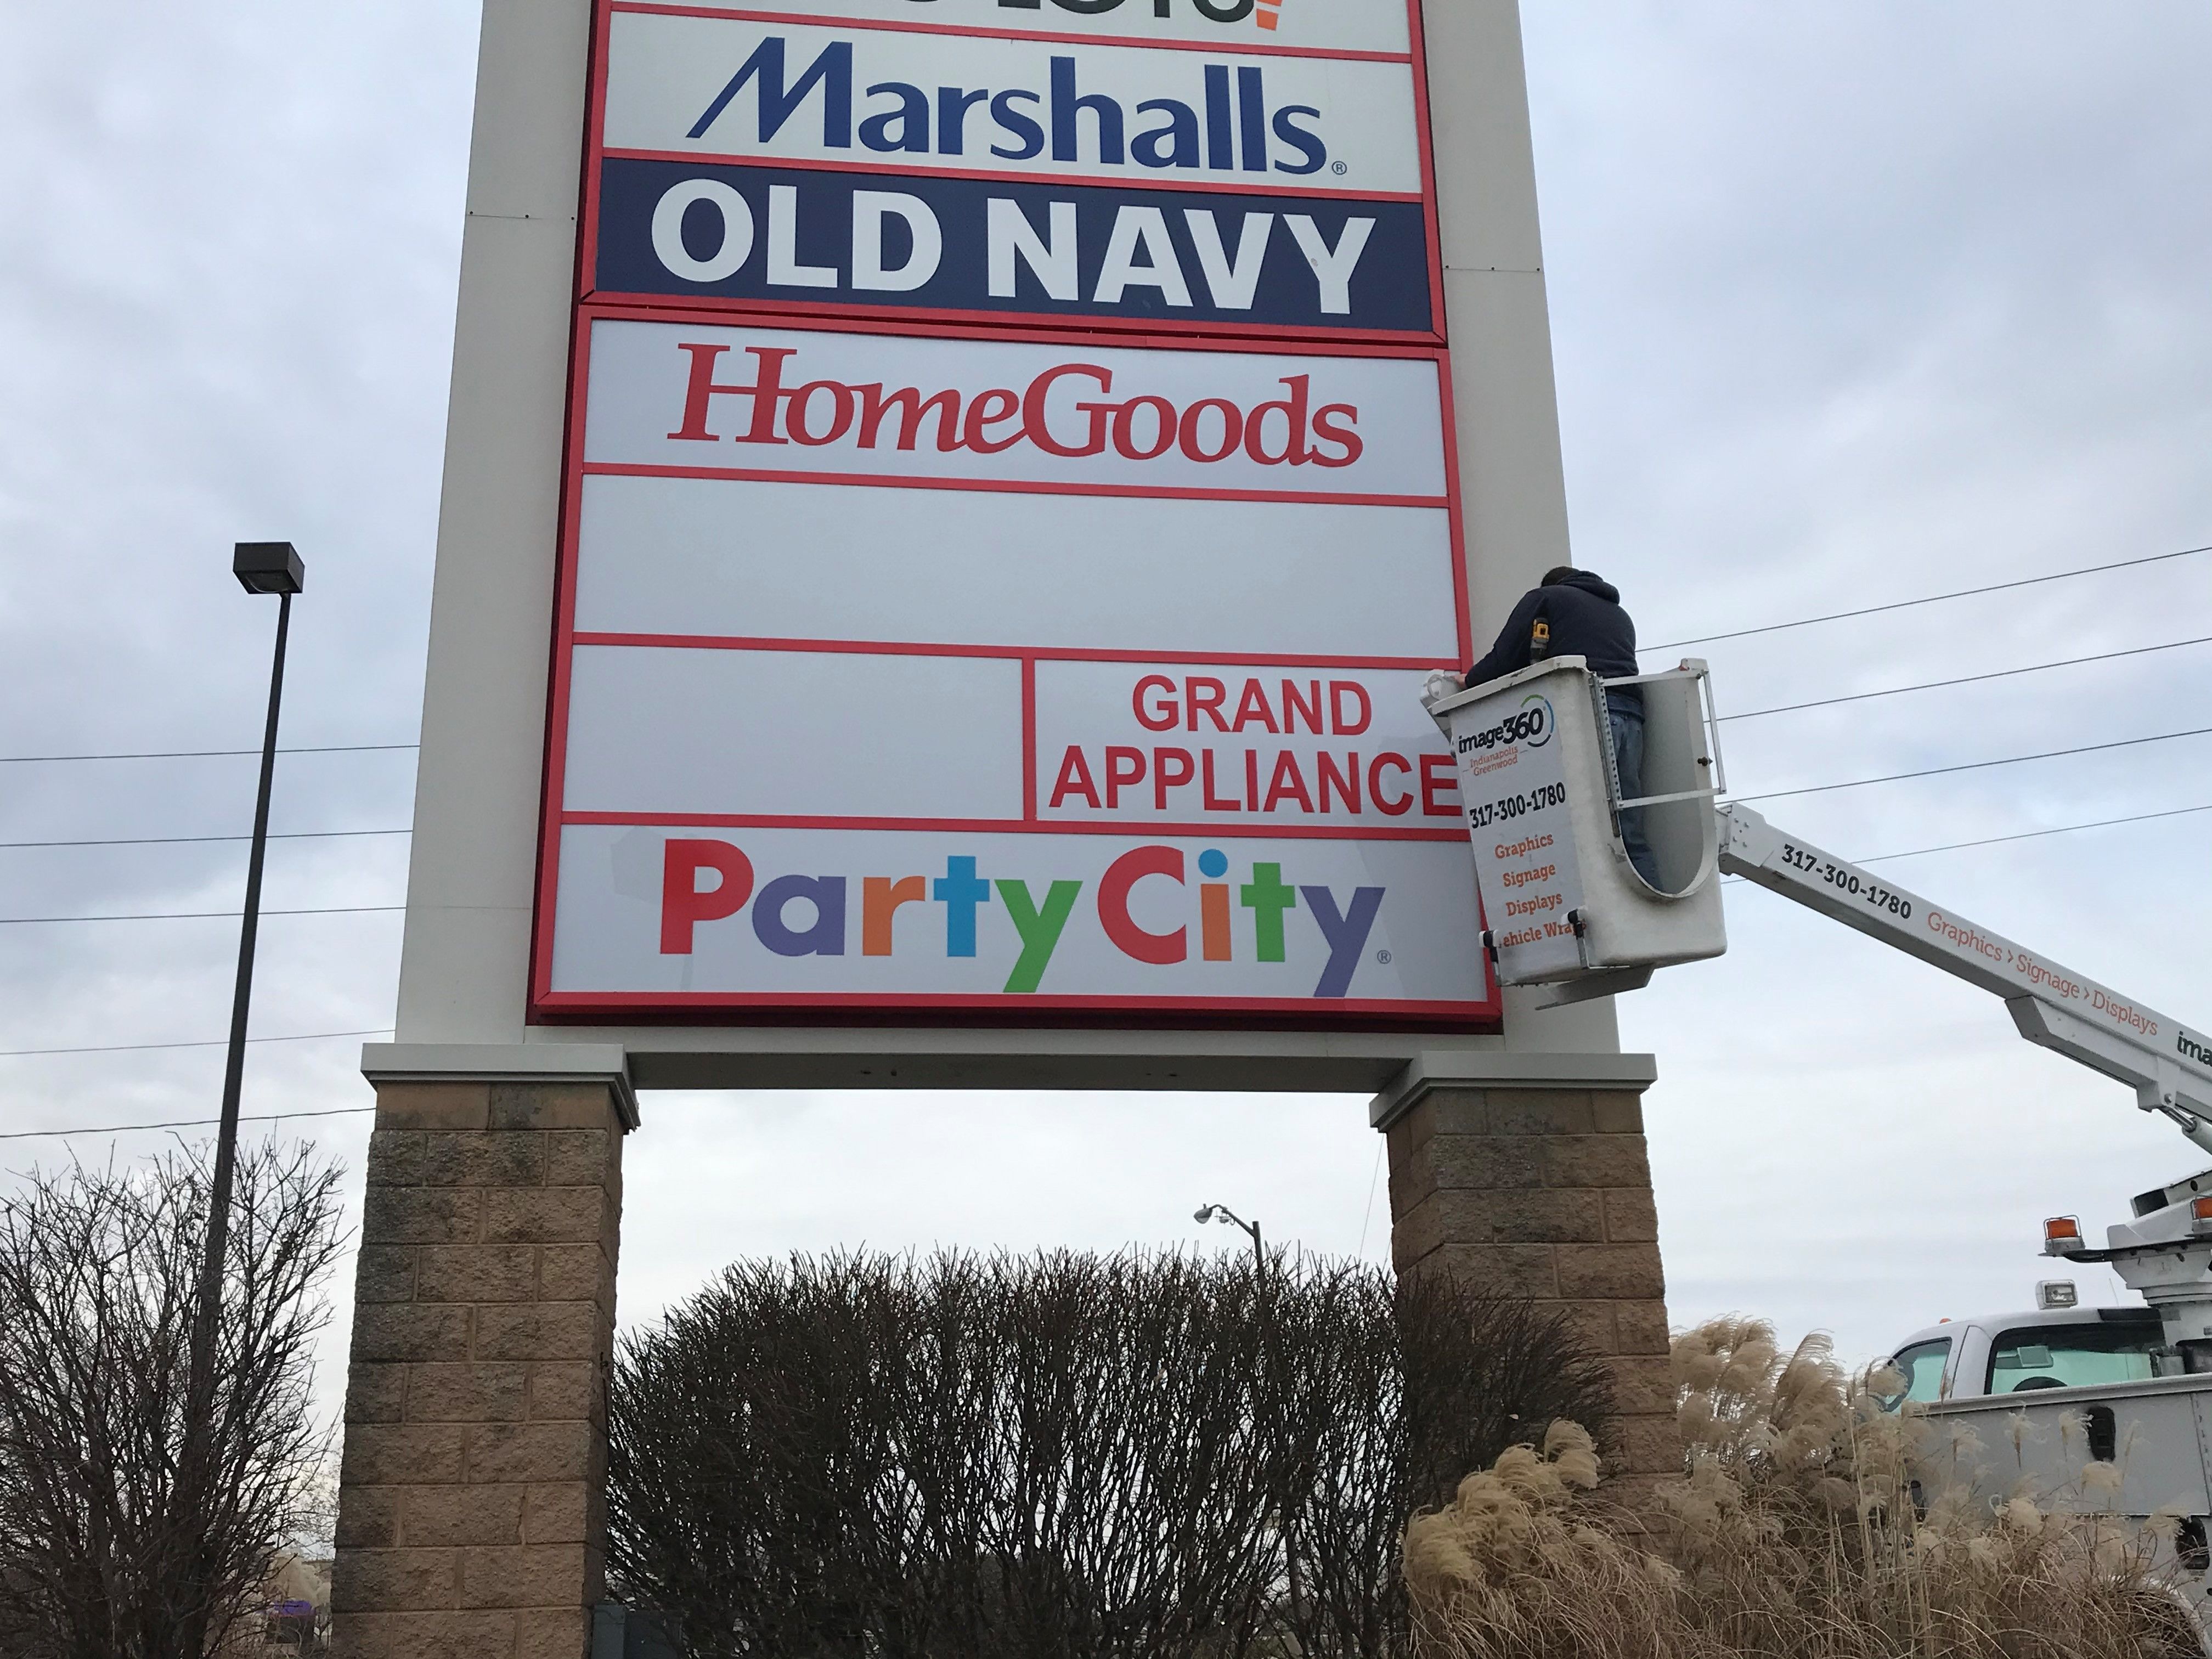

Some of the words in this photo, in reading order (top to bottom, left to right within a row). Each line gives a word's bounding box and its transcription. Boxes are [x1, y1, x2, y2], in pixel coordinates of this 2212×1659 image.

[651, 179, 942, 291] OLD
[987, 198, 1376, 314] NAVY
[667, 343, 1363, 467] HomeGoods
[1132, 675, 1371, 735] GRAND
[1459, 707, 1544, 754] image360
[1049, 745, 1463, 816] APPLIANCE
[1470, 746, 1518, 768] Indianapolis
[1474, 755, 1518, 776] Greenwood
[1469, 782, 1566, 829] 317-300-1780
[1495, 834, 1554, 859] Graphics
[1503, 864, 1556, 887] Signage
[1506, 893, 1563, 916] Displays
[1499, 927, 1542, 949] ehicle
[1781, 843, 1912, 919] 317-300-1780
[1928, 912, 2002, 962] Graphics
[2017, 954, 2080, 998] Signage
[2092, 990, 2158, 1036] Displays
